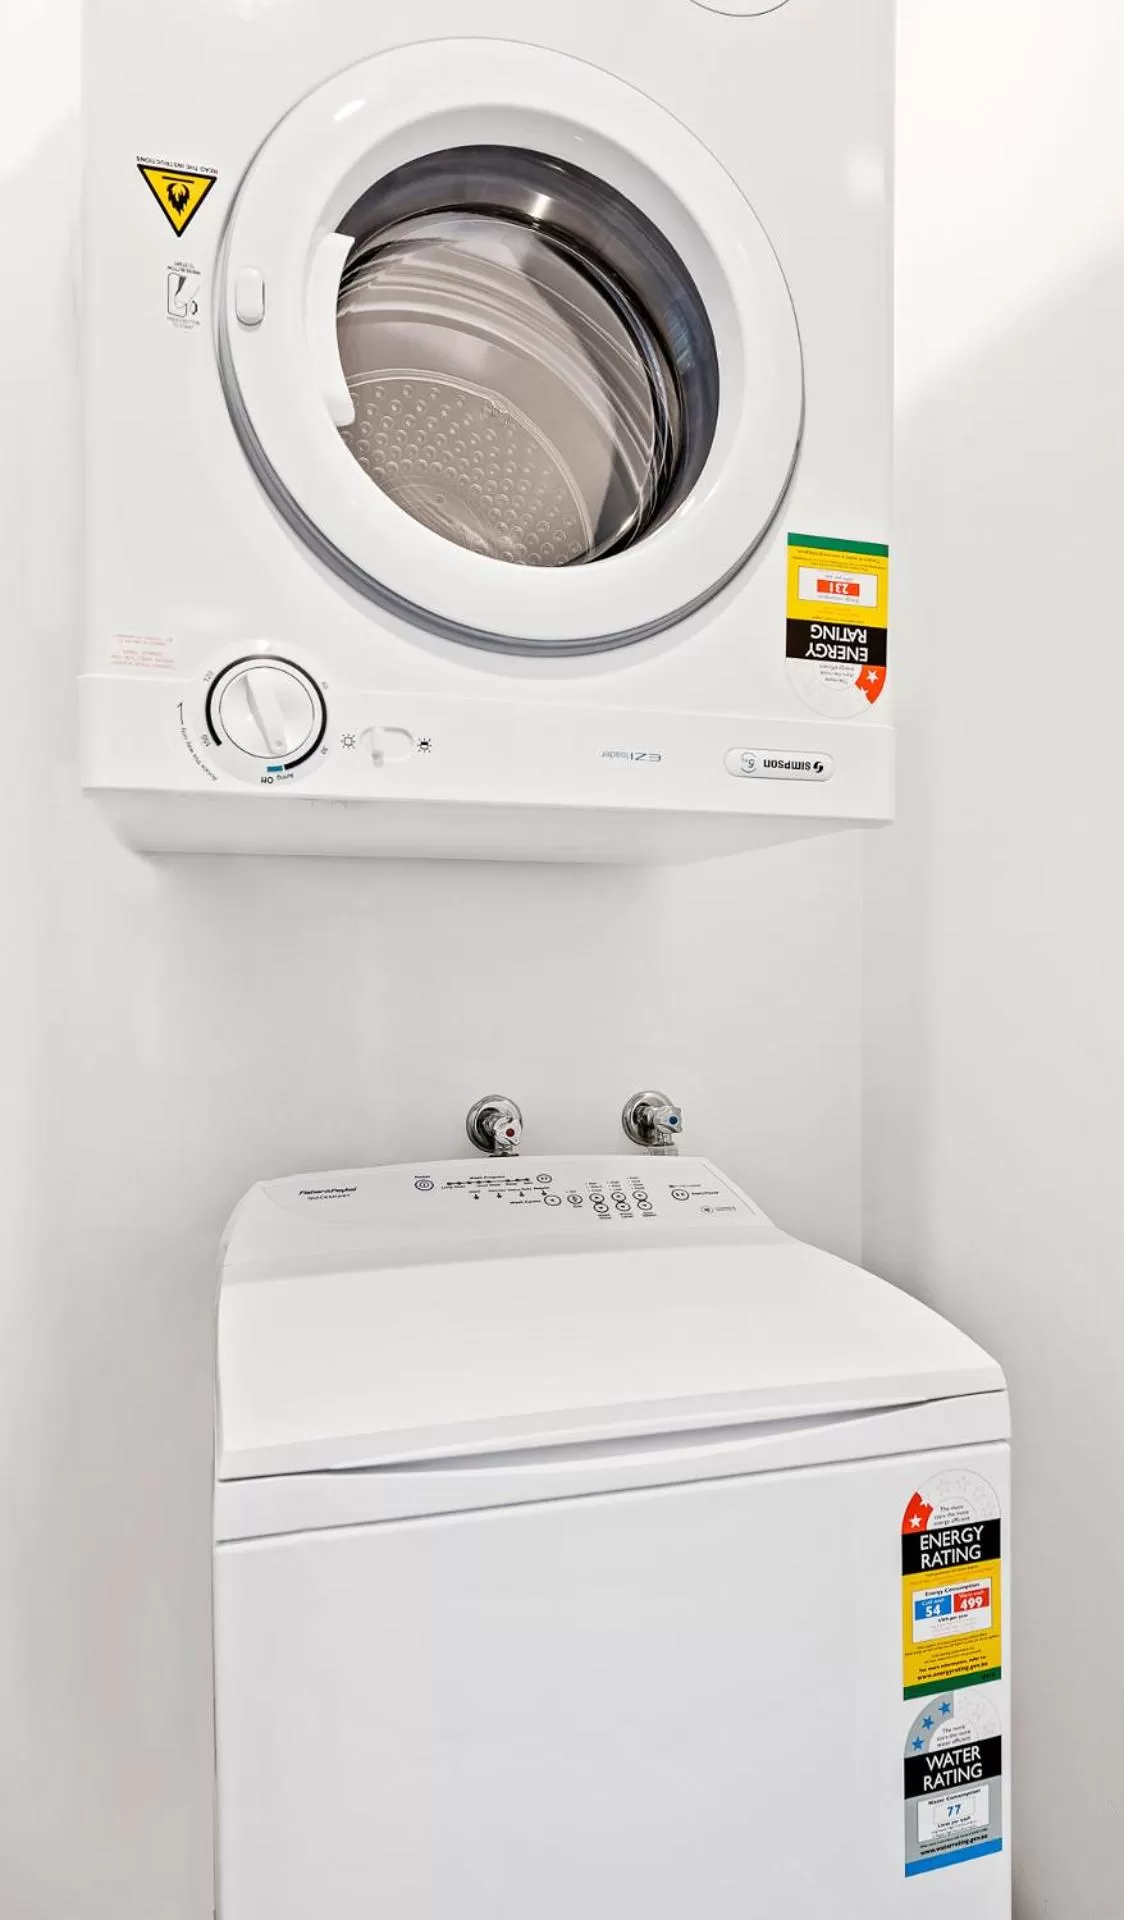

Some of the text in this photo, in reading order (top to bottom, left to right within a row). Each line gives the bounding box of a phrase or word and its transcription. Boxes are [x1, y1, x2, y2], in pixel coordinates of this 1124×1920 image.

[829, 581, 849, 595] 231
[810, 624, 867, 644] RATING
[805, 642, 869, 662] ENERGY
[763, 759, 811, 771] SIMPSON
[260, 776, 274, 784] Off
[920, 1525, 984, 1551] ENERGY
[921, 1544, 981, 1569] RATING
[925, 1589, 943, 1597] Energy
[960, 1596, 983, 1610] 499
[925, 1604, 941, 1617] 54
[925, 1745, 982, 1772] WATER
[923, 1763, 983, 1791] RATING
[947, 1803, 961, 1817] 77
